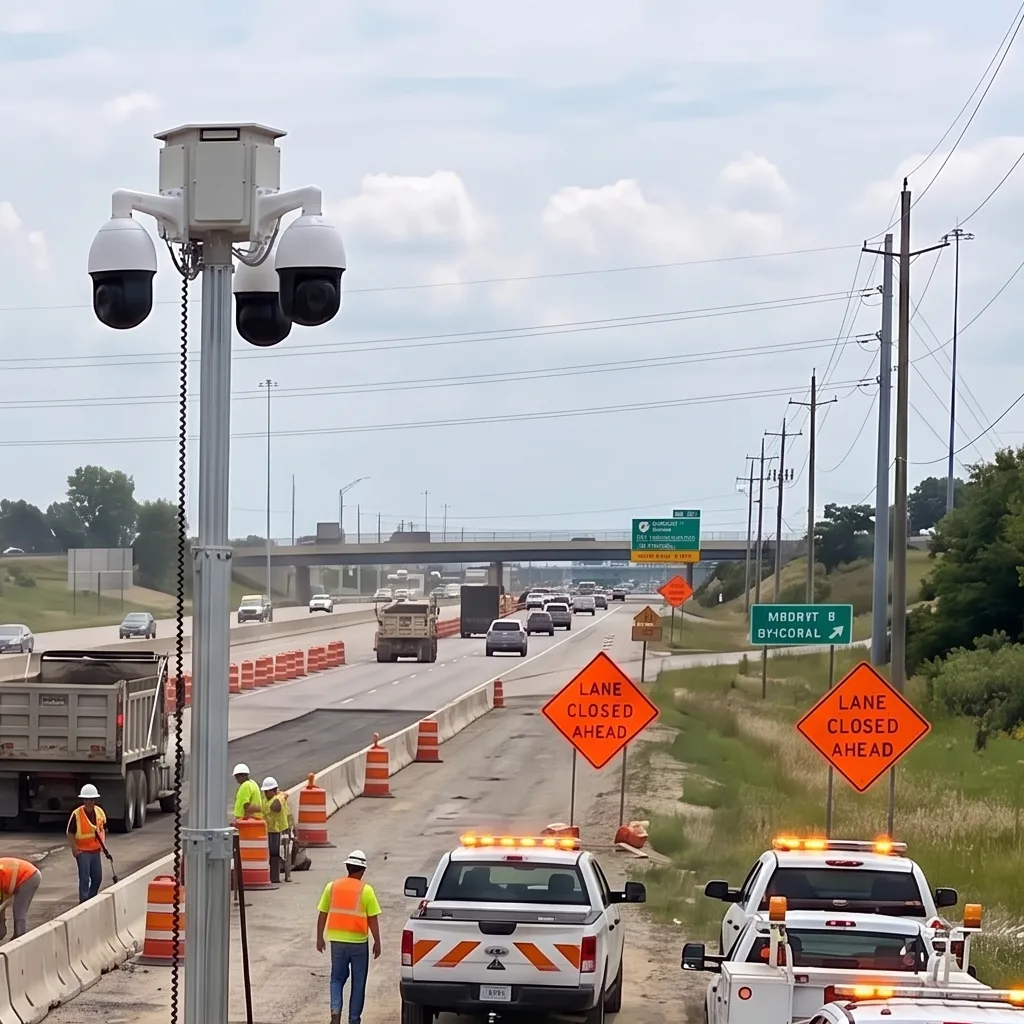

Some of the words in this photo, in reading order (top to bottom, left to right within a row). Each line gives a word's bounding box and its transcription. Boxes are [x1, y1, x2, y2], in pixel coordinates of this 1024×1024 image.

[579, 682, 622, 696] LANE
[839, 695, 887, 710] LANE
[567, 704, 633, 718] CLOSED
[572, 725, 627, 739] AHEAD
[827, 718, 899, 734] CLOSED
[831, 742, 894, 758] AHEAD
